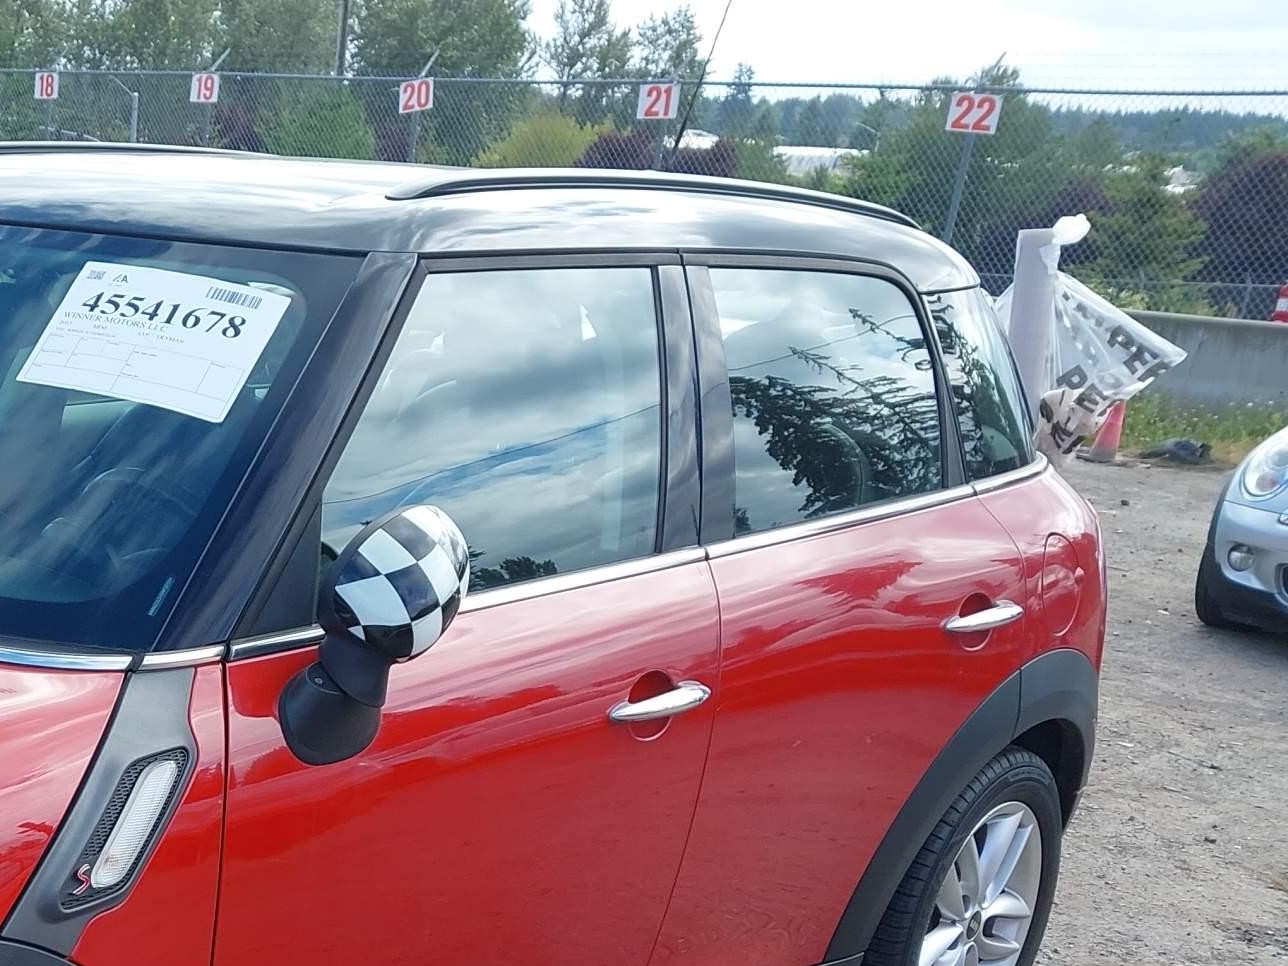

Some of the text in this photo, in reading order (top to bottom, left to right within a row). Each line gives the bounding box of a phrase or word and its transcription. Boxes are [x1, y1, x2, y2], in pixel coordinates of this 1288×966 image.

[40, 74, 54, 97] 18
[196, 74, 215, 101] 19
[402, 80, 430, 111] 20
[644, 85, 673, 117] 21
[951, 95, 996, 131] 22
[64, 311, 103, 323] WINNER
[104, 316, 147, 328] MOTORS
[81, 291, 247, 339] 45541678
